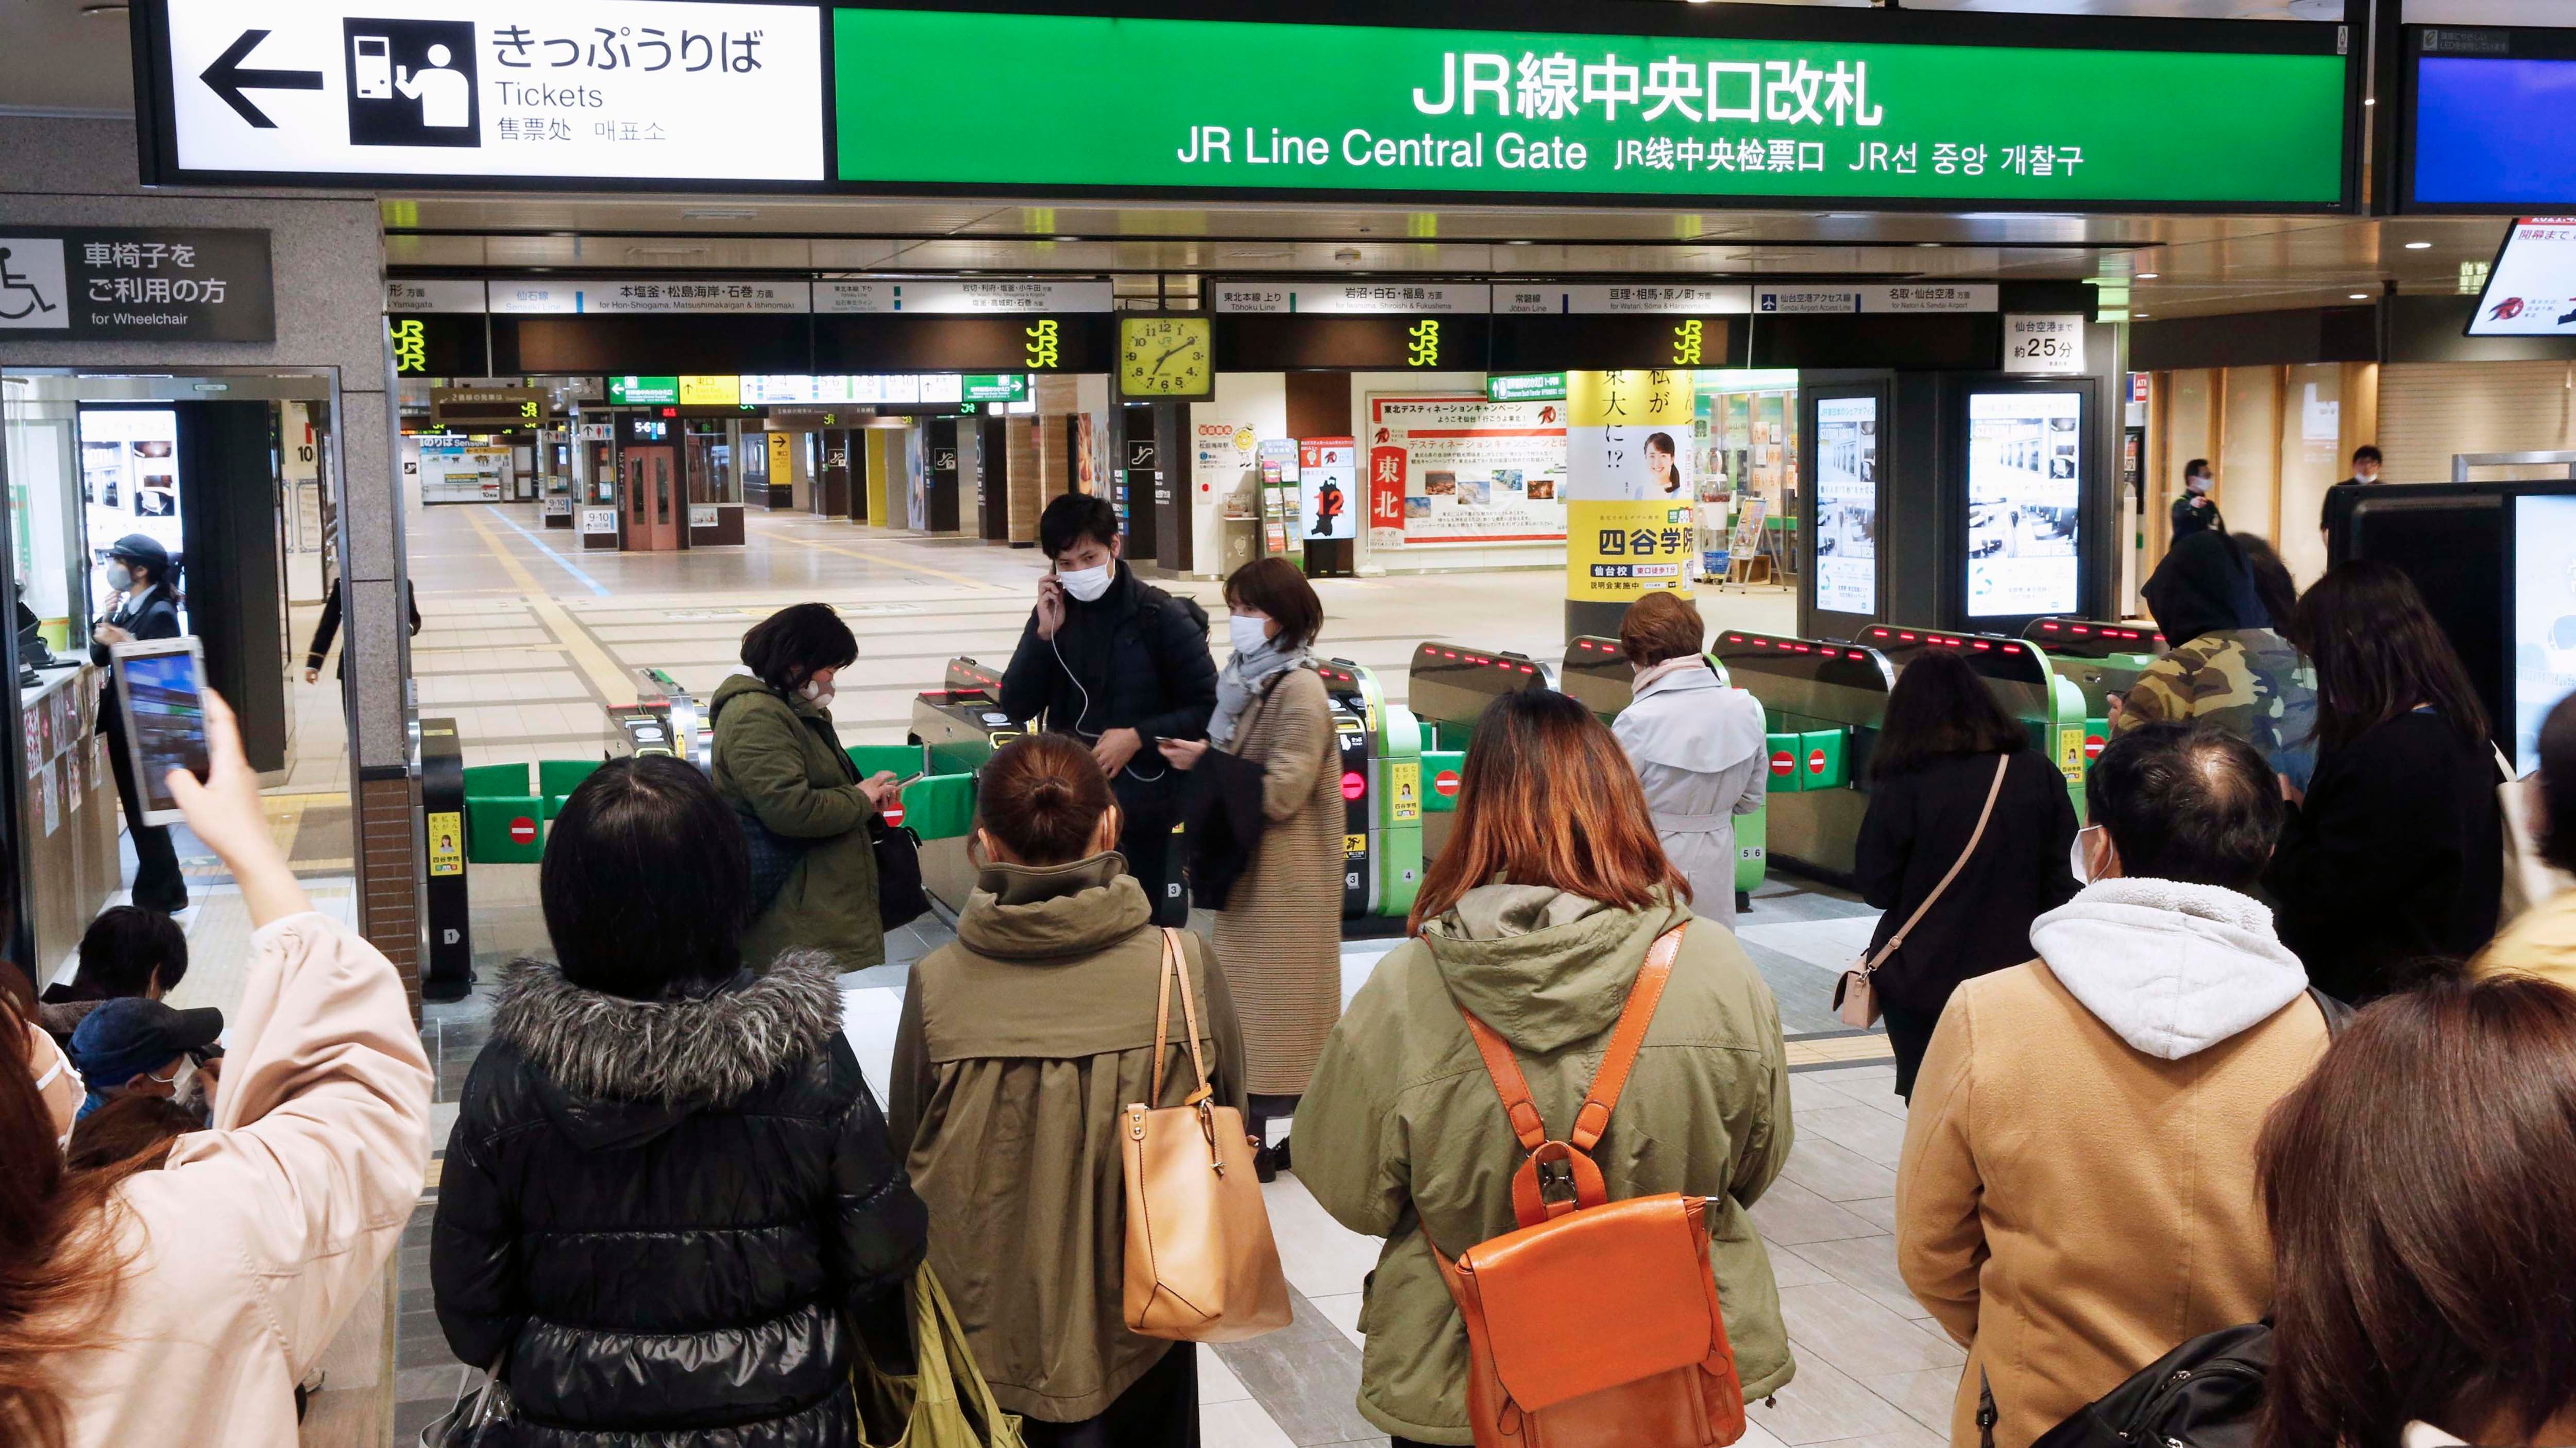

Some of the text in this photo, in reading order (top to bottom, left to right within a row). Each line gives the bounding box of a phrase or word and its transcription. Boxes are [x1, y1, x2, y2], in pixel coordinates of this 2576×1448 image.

[493, 25, 764, 73] きっぷうりば
[495, 81, 603, 108] Tickets
[1412, 52, 1883, 127] JR線中央口改札
[497, 117, 666, 142] 售票处 매표소
[1177, 126, 2084, 177] JR Line Central Gate JR线中央检票口 JR선 중앙 개찰구
[83, 242, 196, 268] 車椅子を
[89, 277, 227, 304] ご利用の方
[406, 288, 425, 297] 方面
[1345, 287, 1443, 300] 岩沼・白石・福島 方面
[1889, 288, 1955, 300] 名取・仙台空港
[517, 291, 549, 301] 仙石線
[1224, 292, 1281, 302] 東北本線 上り
[393, 301, 433, 310] Yamagata
[91, 313, 189, 325] for Wheelchair
[1146, 328, 1156, 336] 11
[1159, 323, 1171, 332] 12
[1177, 327, 1182, 336] 1
[2015, 321, 2074, 333] 仙台空港まで
[1134, 338, 1146, 347] 10
[2014, 338, 2073, 359] 約25分
[1128, 352, 1137, 361] 9
[1192, 352, 1201, 361] 3
[1135, 367, 1144, 376] 8
[1185, 367, 1195, 376] 4
[1147, 377, 1155, 386] 7
[1161, 380, 1169, 389] 6
[1175, 377, 1183, 386] 5
[1647, 370, 1671, 414] 私が
[1384, 403, 1522, 414] 東北デスティネーションキャンペーン
[297, 446, 313, 462] 10
[1374, 455, 1400, 518] 東北
[1314, 490, 1344, 515] 12
[1595, 566, 1675, 576] 仙台校 東口徒歩1分
[1591, 581, 1639, 590] 説明会実施中
[1743, 849, 1760, 858] 5 6
[1350, 875, 1356, 883] 3
[1405, 872, 1411, 880] 4
[1171, 885, 1177, 894] 3
[448, 931, 453, 942] 1
